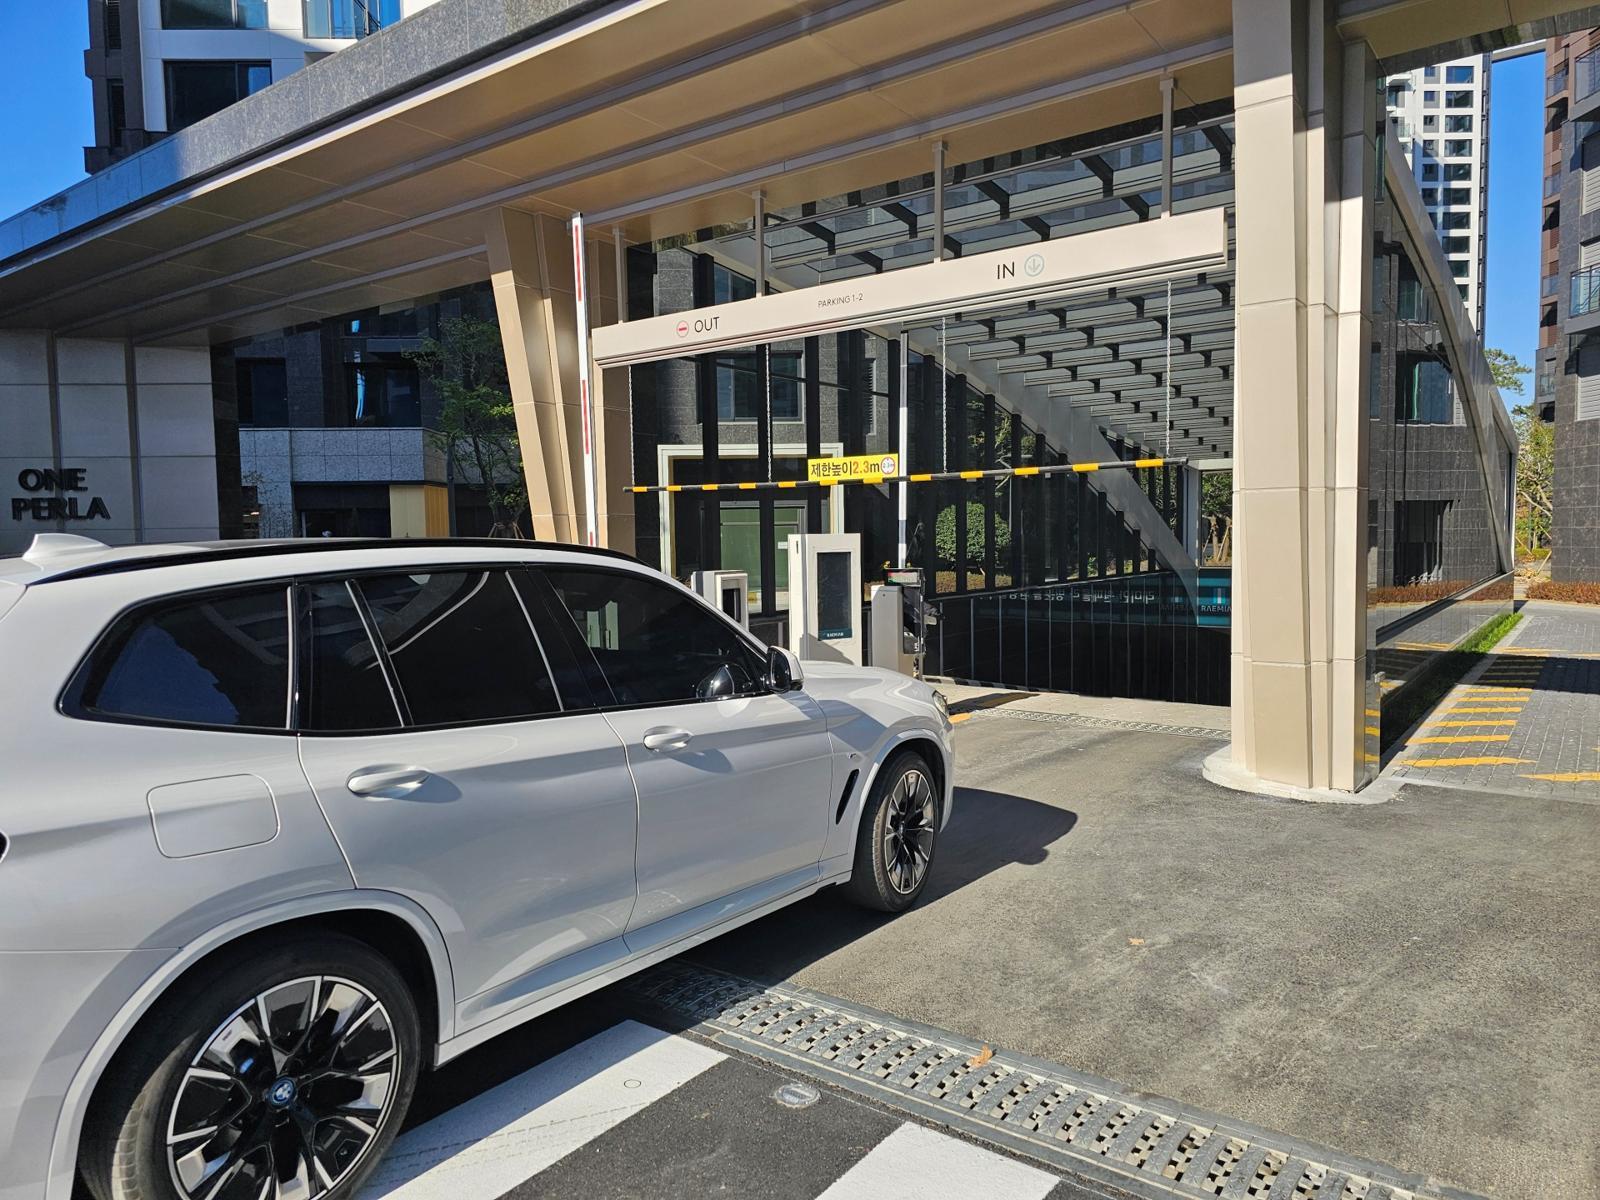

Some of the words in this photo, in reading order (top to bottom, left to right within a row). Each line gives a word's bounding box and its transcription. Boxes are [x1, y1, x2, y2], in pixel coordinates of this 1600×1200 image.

[997, 260, 1015, 280] IN
[818, 295, 851, 308] PARKING
[852, 292, 864, 302] 1-2
[694, 316, 720, 333] OUT
[18, 468, 88, 491] ONE
[11, 497, 111, 521] PERLA
[1200, 605, 1232, 613] RAEMIA
